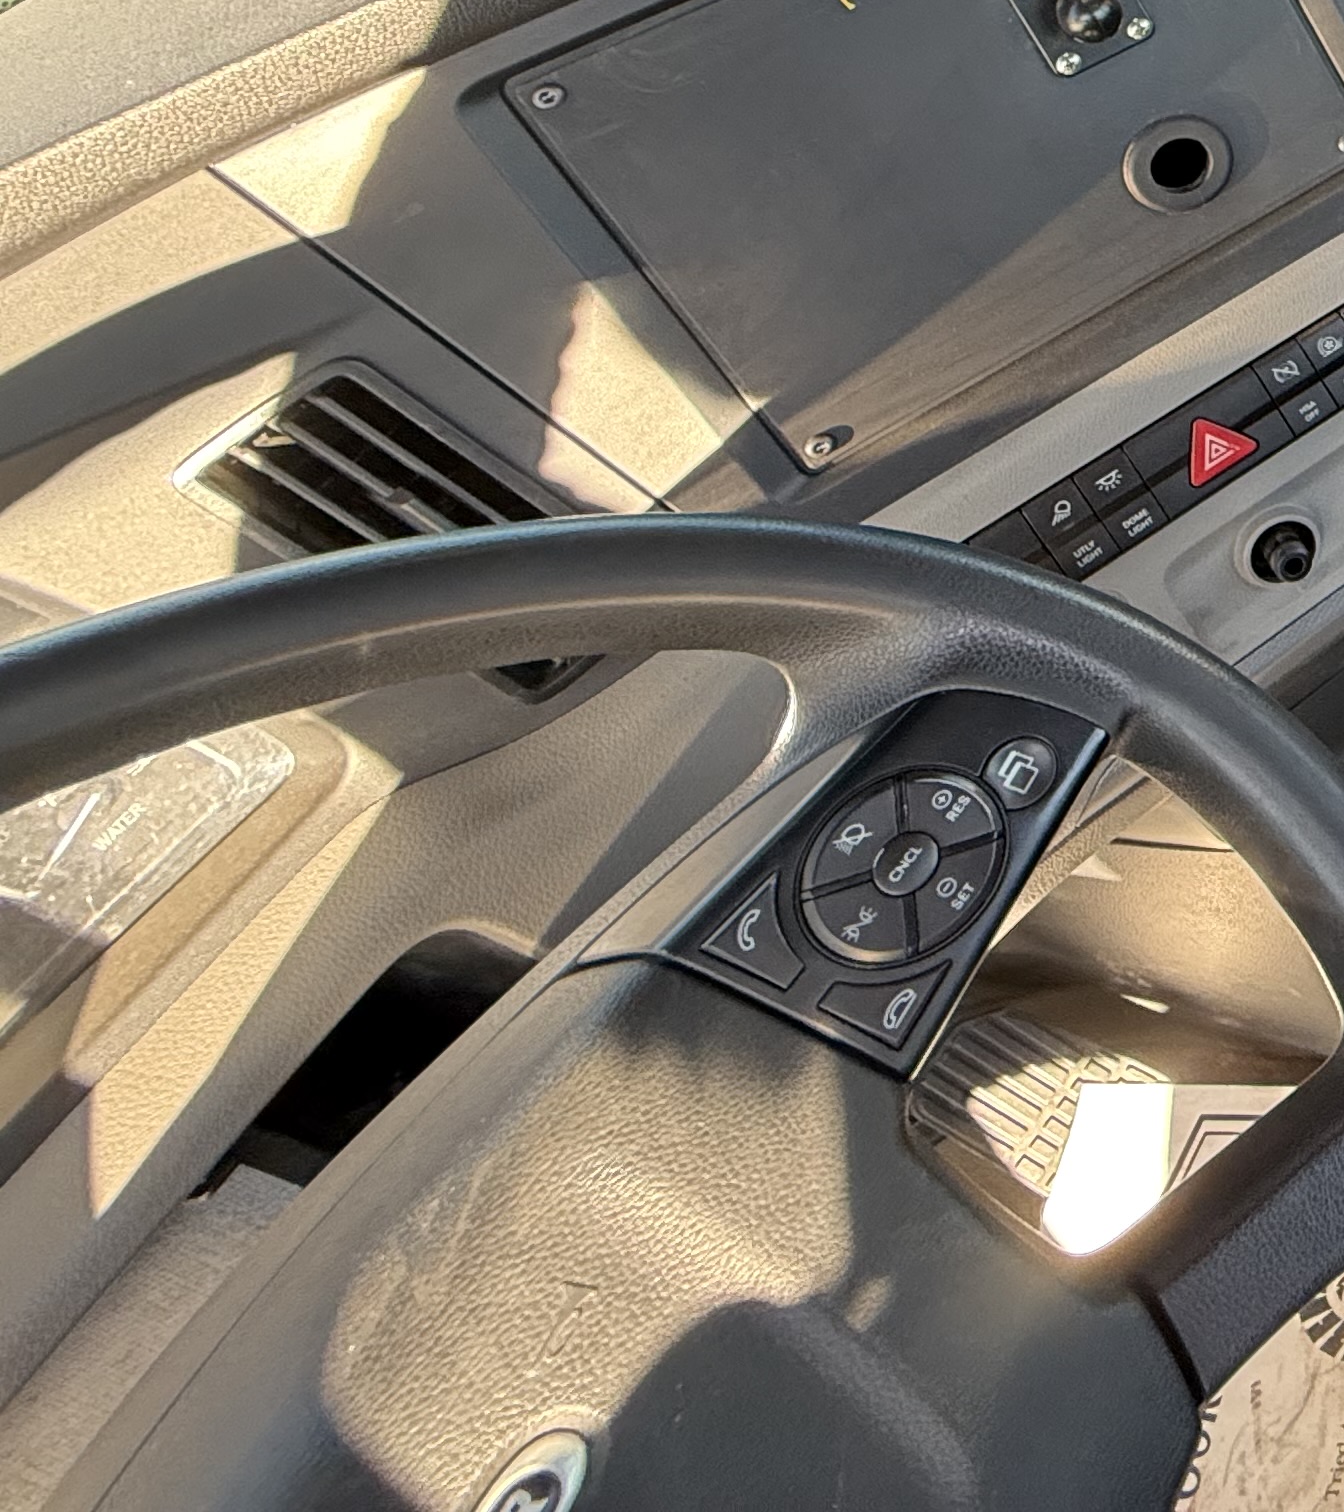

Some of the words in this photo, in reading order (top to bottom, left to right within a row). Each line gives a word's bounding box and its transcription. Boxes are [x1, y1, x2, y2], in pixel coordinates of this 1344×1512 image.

[1304, 408, 1319, 422] OFF
[1122, 508, 1149, 529] DOME
[1127, 515, 1154, 538] LIGHT
[1072, 539, 1095, 559] UTLY
[1076, 547, 1103, 568] LIGHT
[945, 794, 972, 822] RES
[91, 801, 148, 852] WATER
[888, 847, 923, 883] CNCL
[950, 881, 975, 911] SET
